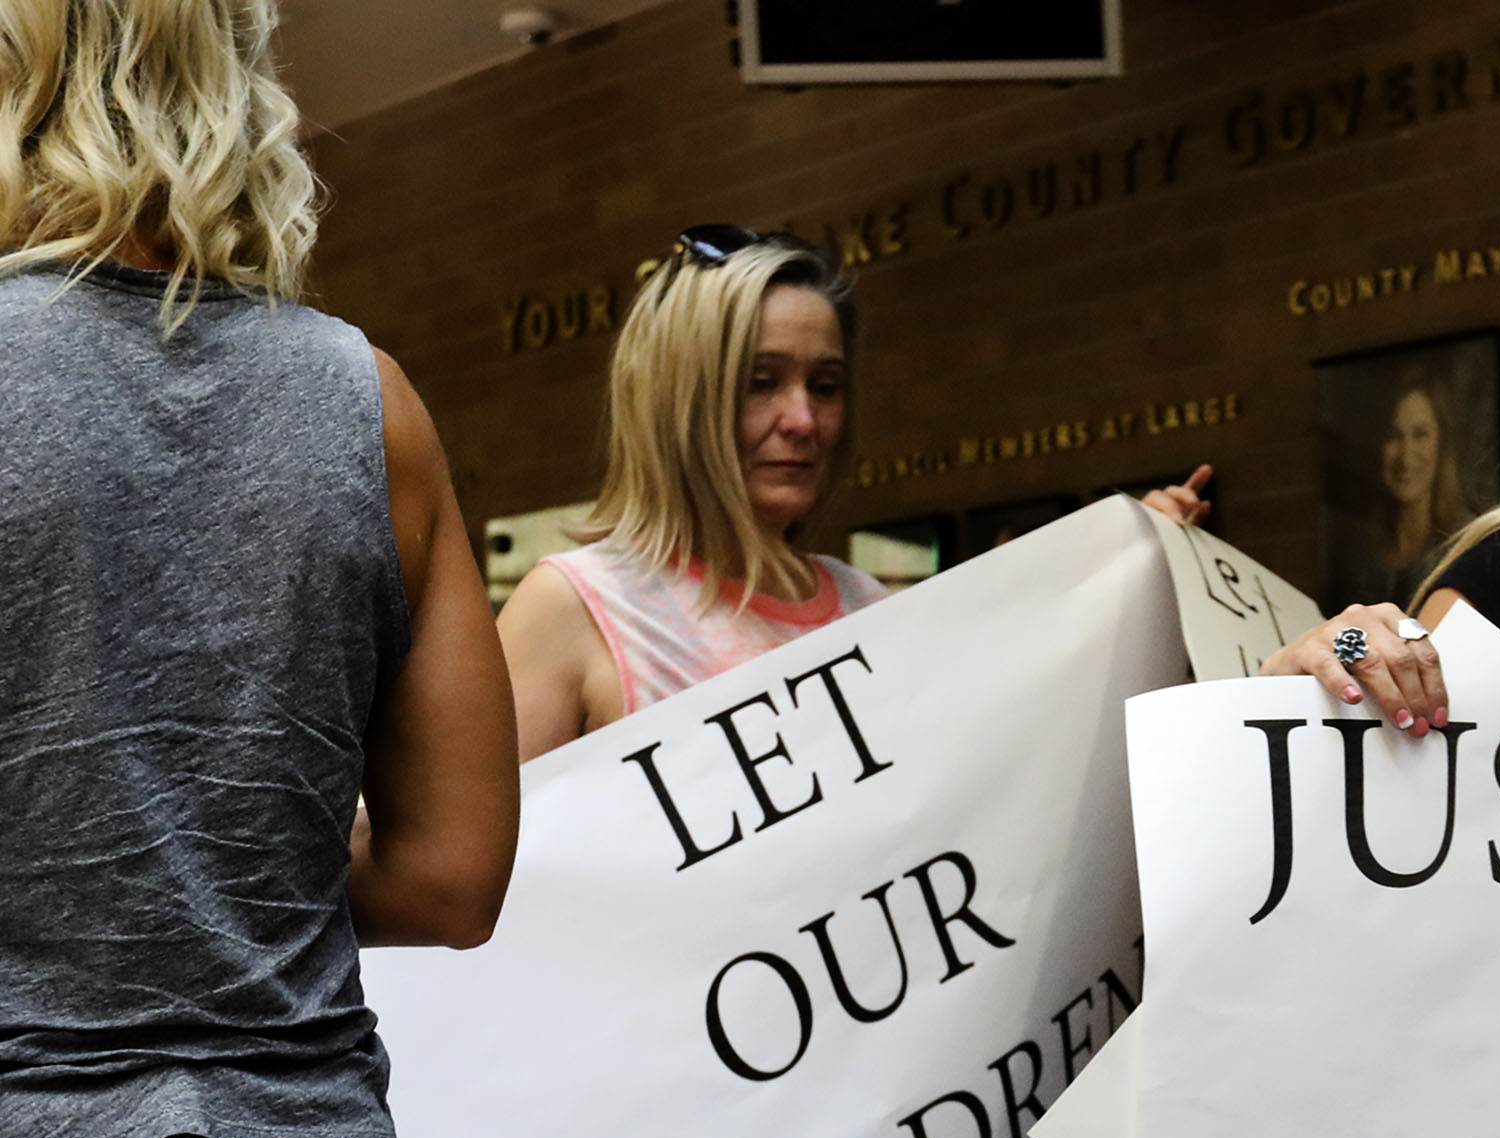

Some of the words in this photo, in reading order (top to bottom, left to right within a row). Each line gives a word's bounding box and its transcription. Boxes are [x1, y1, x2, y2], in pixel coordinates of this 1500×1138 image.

[502, 286, 618, 352] YOUR
[942, 124, 1189, 239] COUNTY
[1288, 264, 1418, 315] COUNTY
[853, 449, 951, 488] OUNCIL
[958, 418, 1092, 466] MEMBERS
[1102, 411, 1138, 441] AT
[1146, 393, 1242, 436] LARGE
[622, 646, 894, 871] LET
[704, 850, 1016, 1082] OUR
